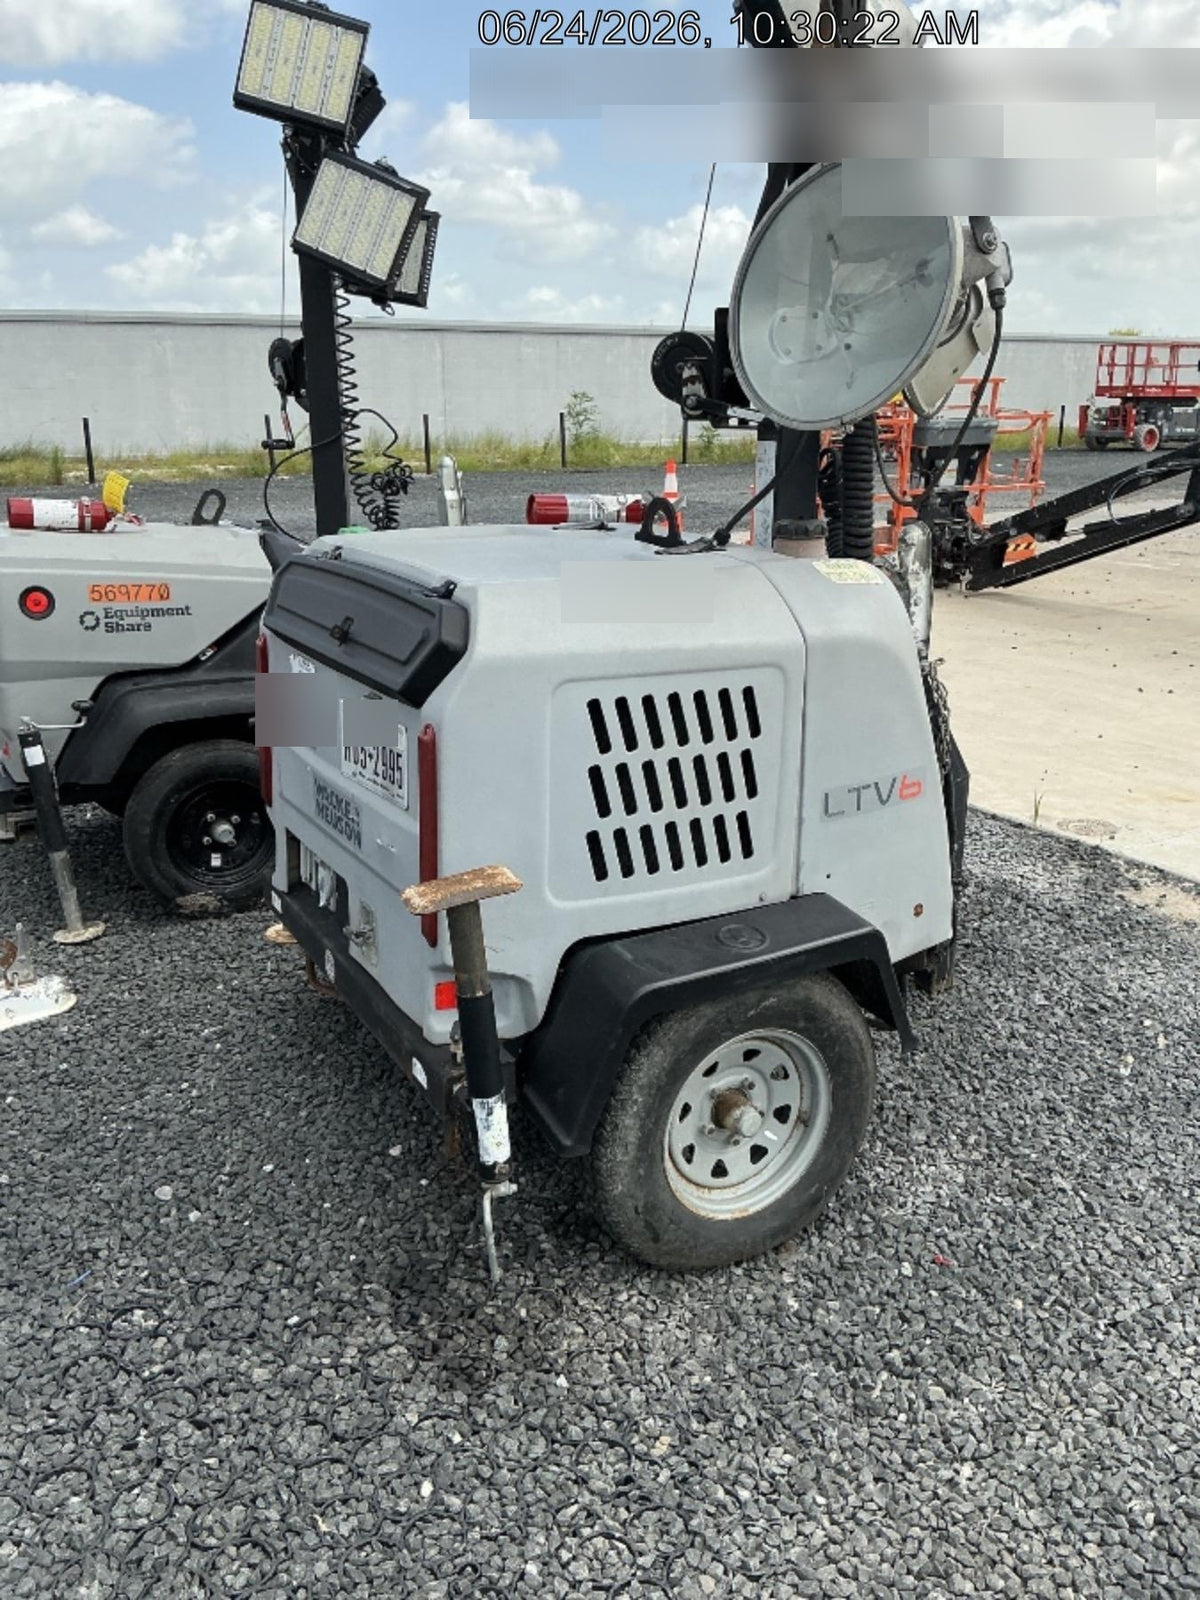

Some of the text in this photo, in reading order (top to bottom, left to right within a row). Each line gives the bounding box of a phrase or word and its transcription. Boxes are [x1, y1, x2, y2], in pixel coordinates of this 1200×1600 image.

[90, 583, 170, 602] 569770
[103, 605, 192, 620] Equipment
[104, 621, 152, 633] Share
[824, 775, 922, 817] LTV6
